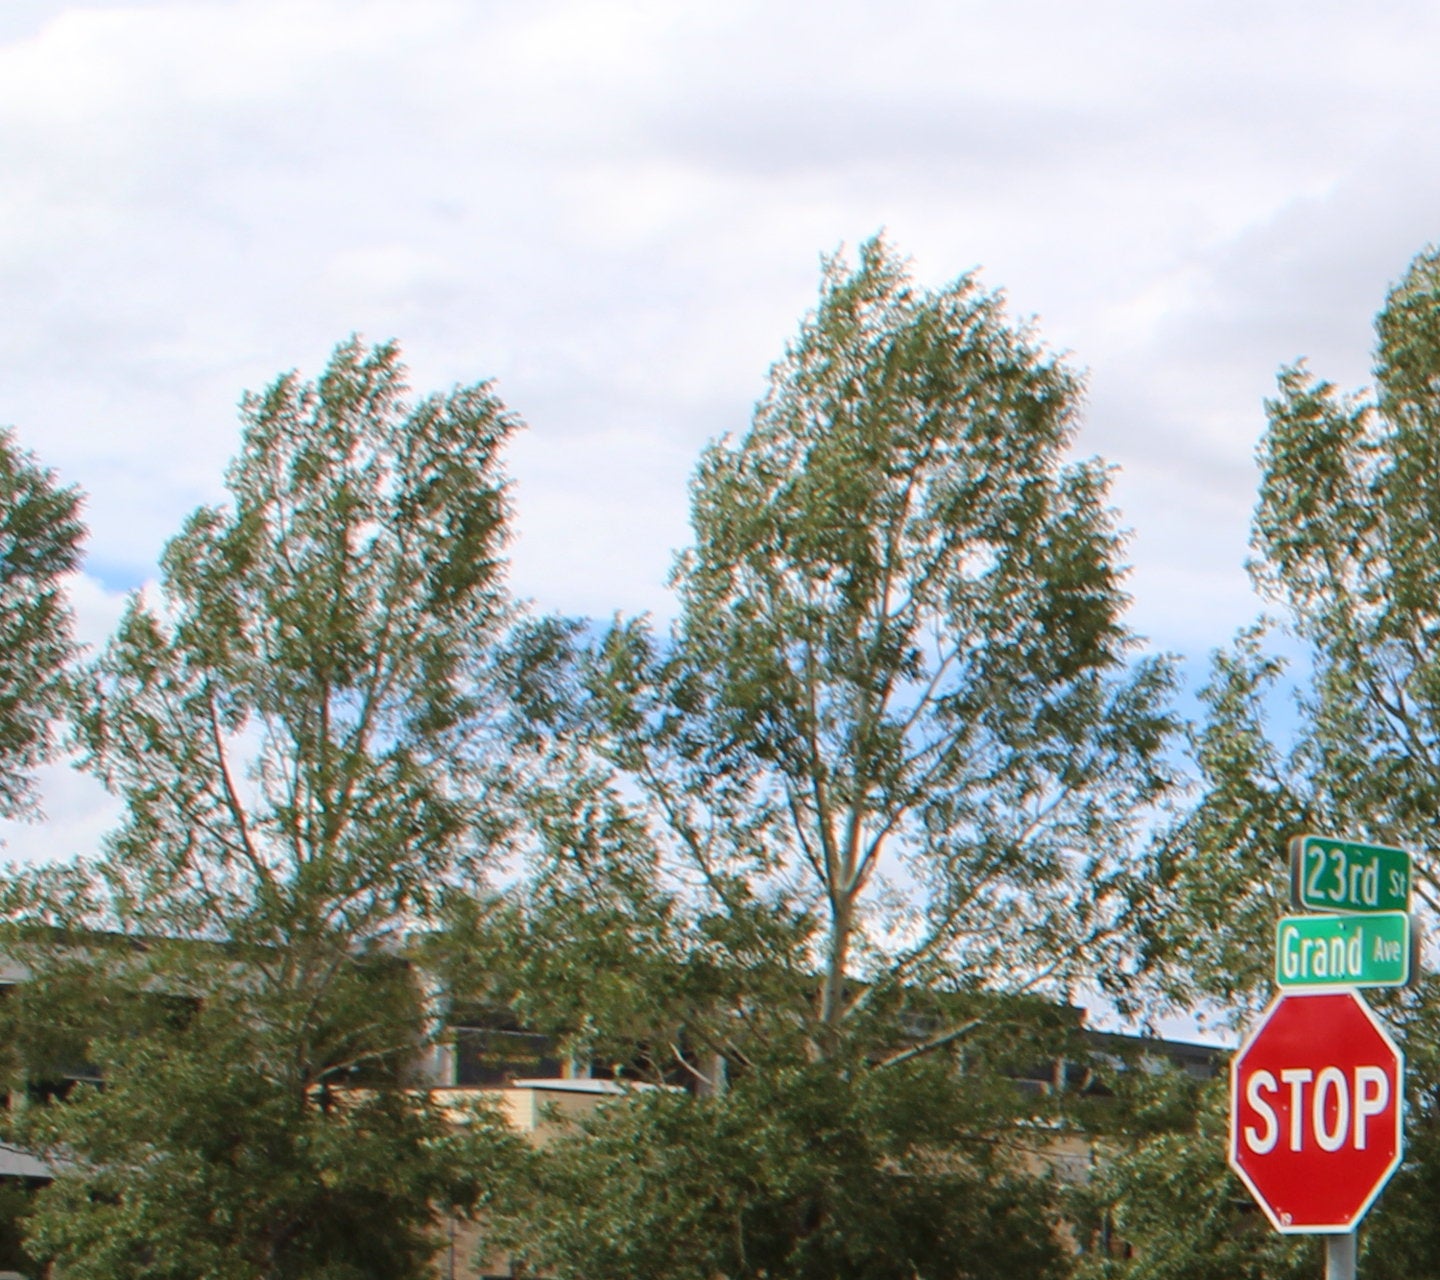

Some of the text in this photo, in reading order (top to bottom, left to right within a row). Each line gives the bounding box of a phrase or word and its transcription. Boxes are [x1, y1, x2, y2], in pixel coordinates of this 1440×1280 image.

[1306, 844, 1407, 907] 23rd St
[1282, 925, 1401, 980] Grand Ave
[1244, 1065, 1390, 1154] STOP
